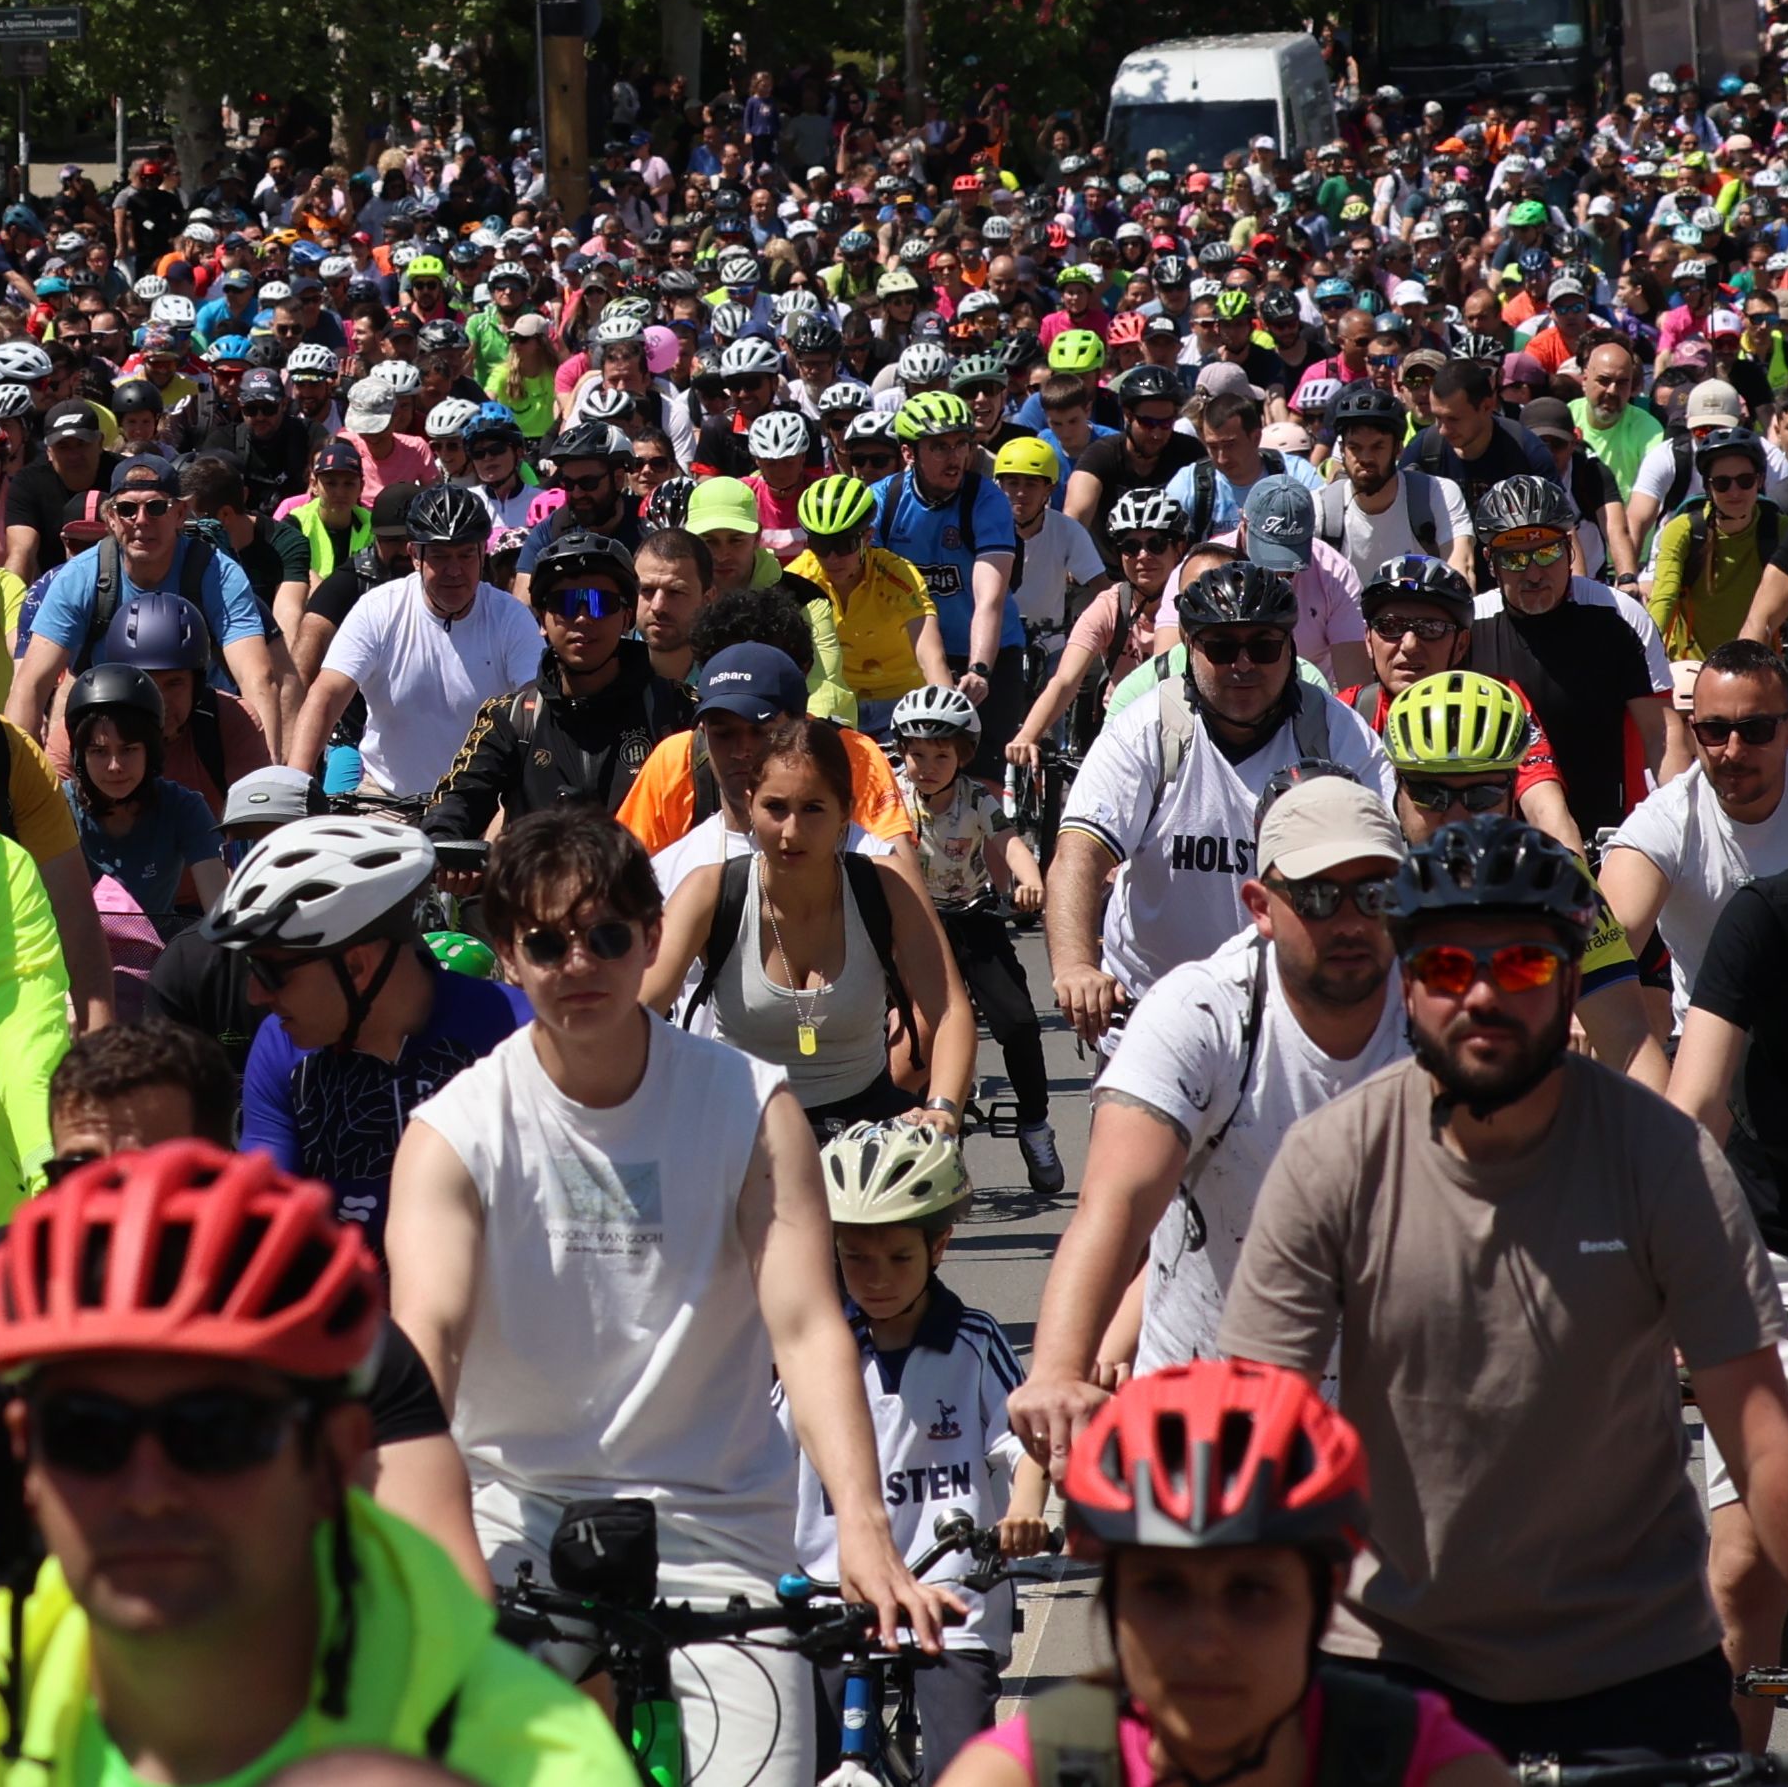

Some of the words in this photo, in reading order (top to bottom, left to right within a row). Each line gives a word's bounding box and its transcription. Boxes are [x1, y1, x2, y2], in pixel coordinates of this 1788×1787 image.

[1261, 515, 1305, 536] Italia
[709, 671, 752, 686] InShare
[597, 1231, 627, 1243] VAN
[627, 1232, 664, 1245] GOGH
